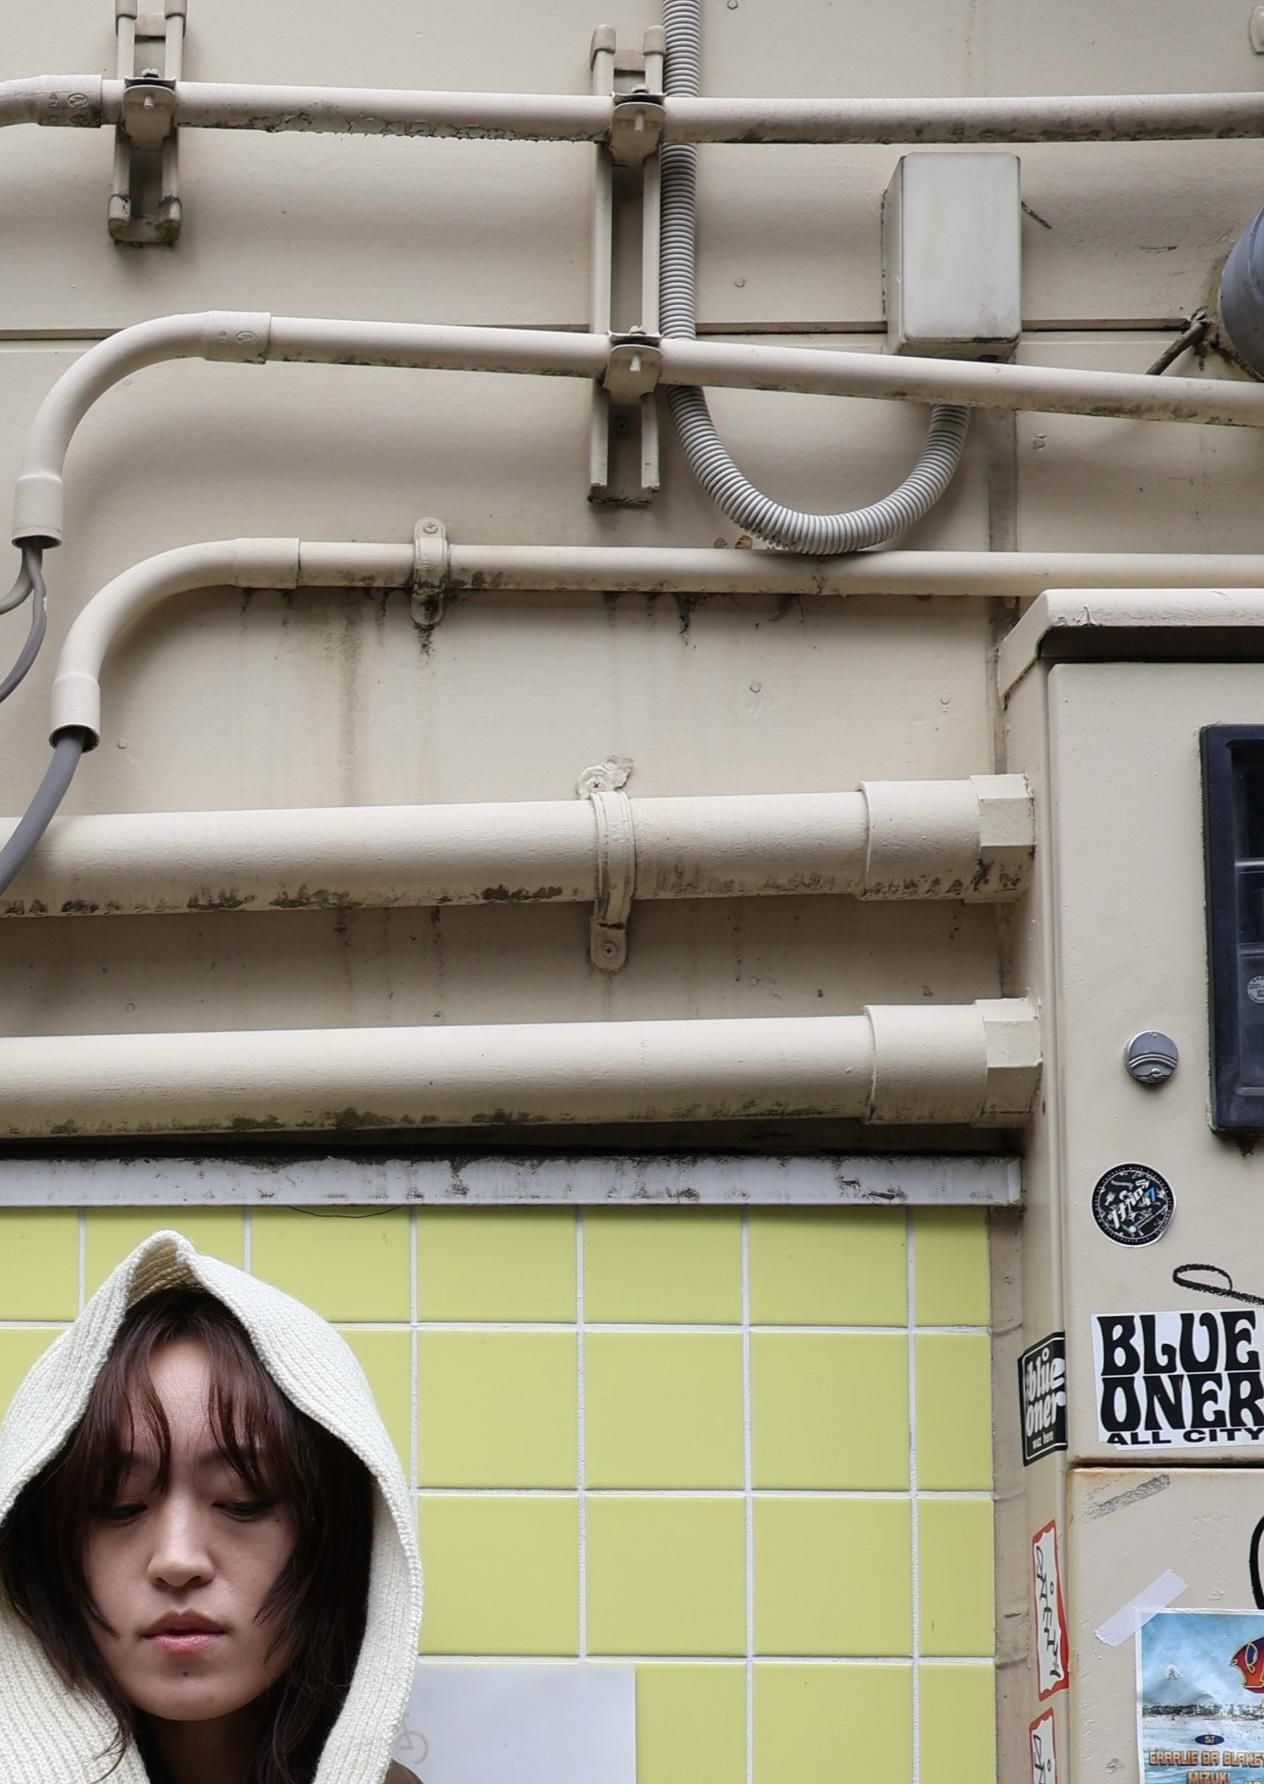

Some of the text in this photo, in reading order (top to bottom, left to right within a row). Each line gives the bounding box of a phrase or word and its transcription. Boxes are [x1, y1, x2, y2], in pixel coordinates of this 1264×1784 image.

[1097, 1311, 1260, 1376] BLUE
[1100, 1371, 1264, 1432] ONER
[1107, 1427, 1264, 1446] ALL CITY
